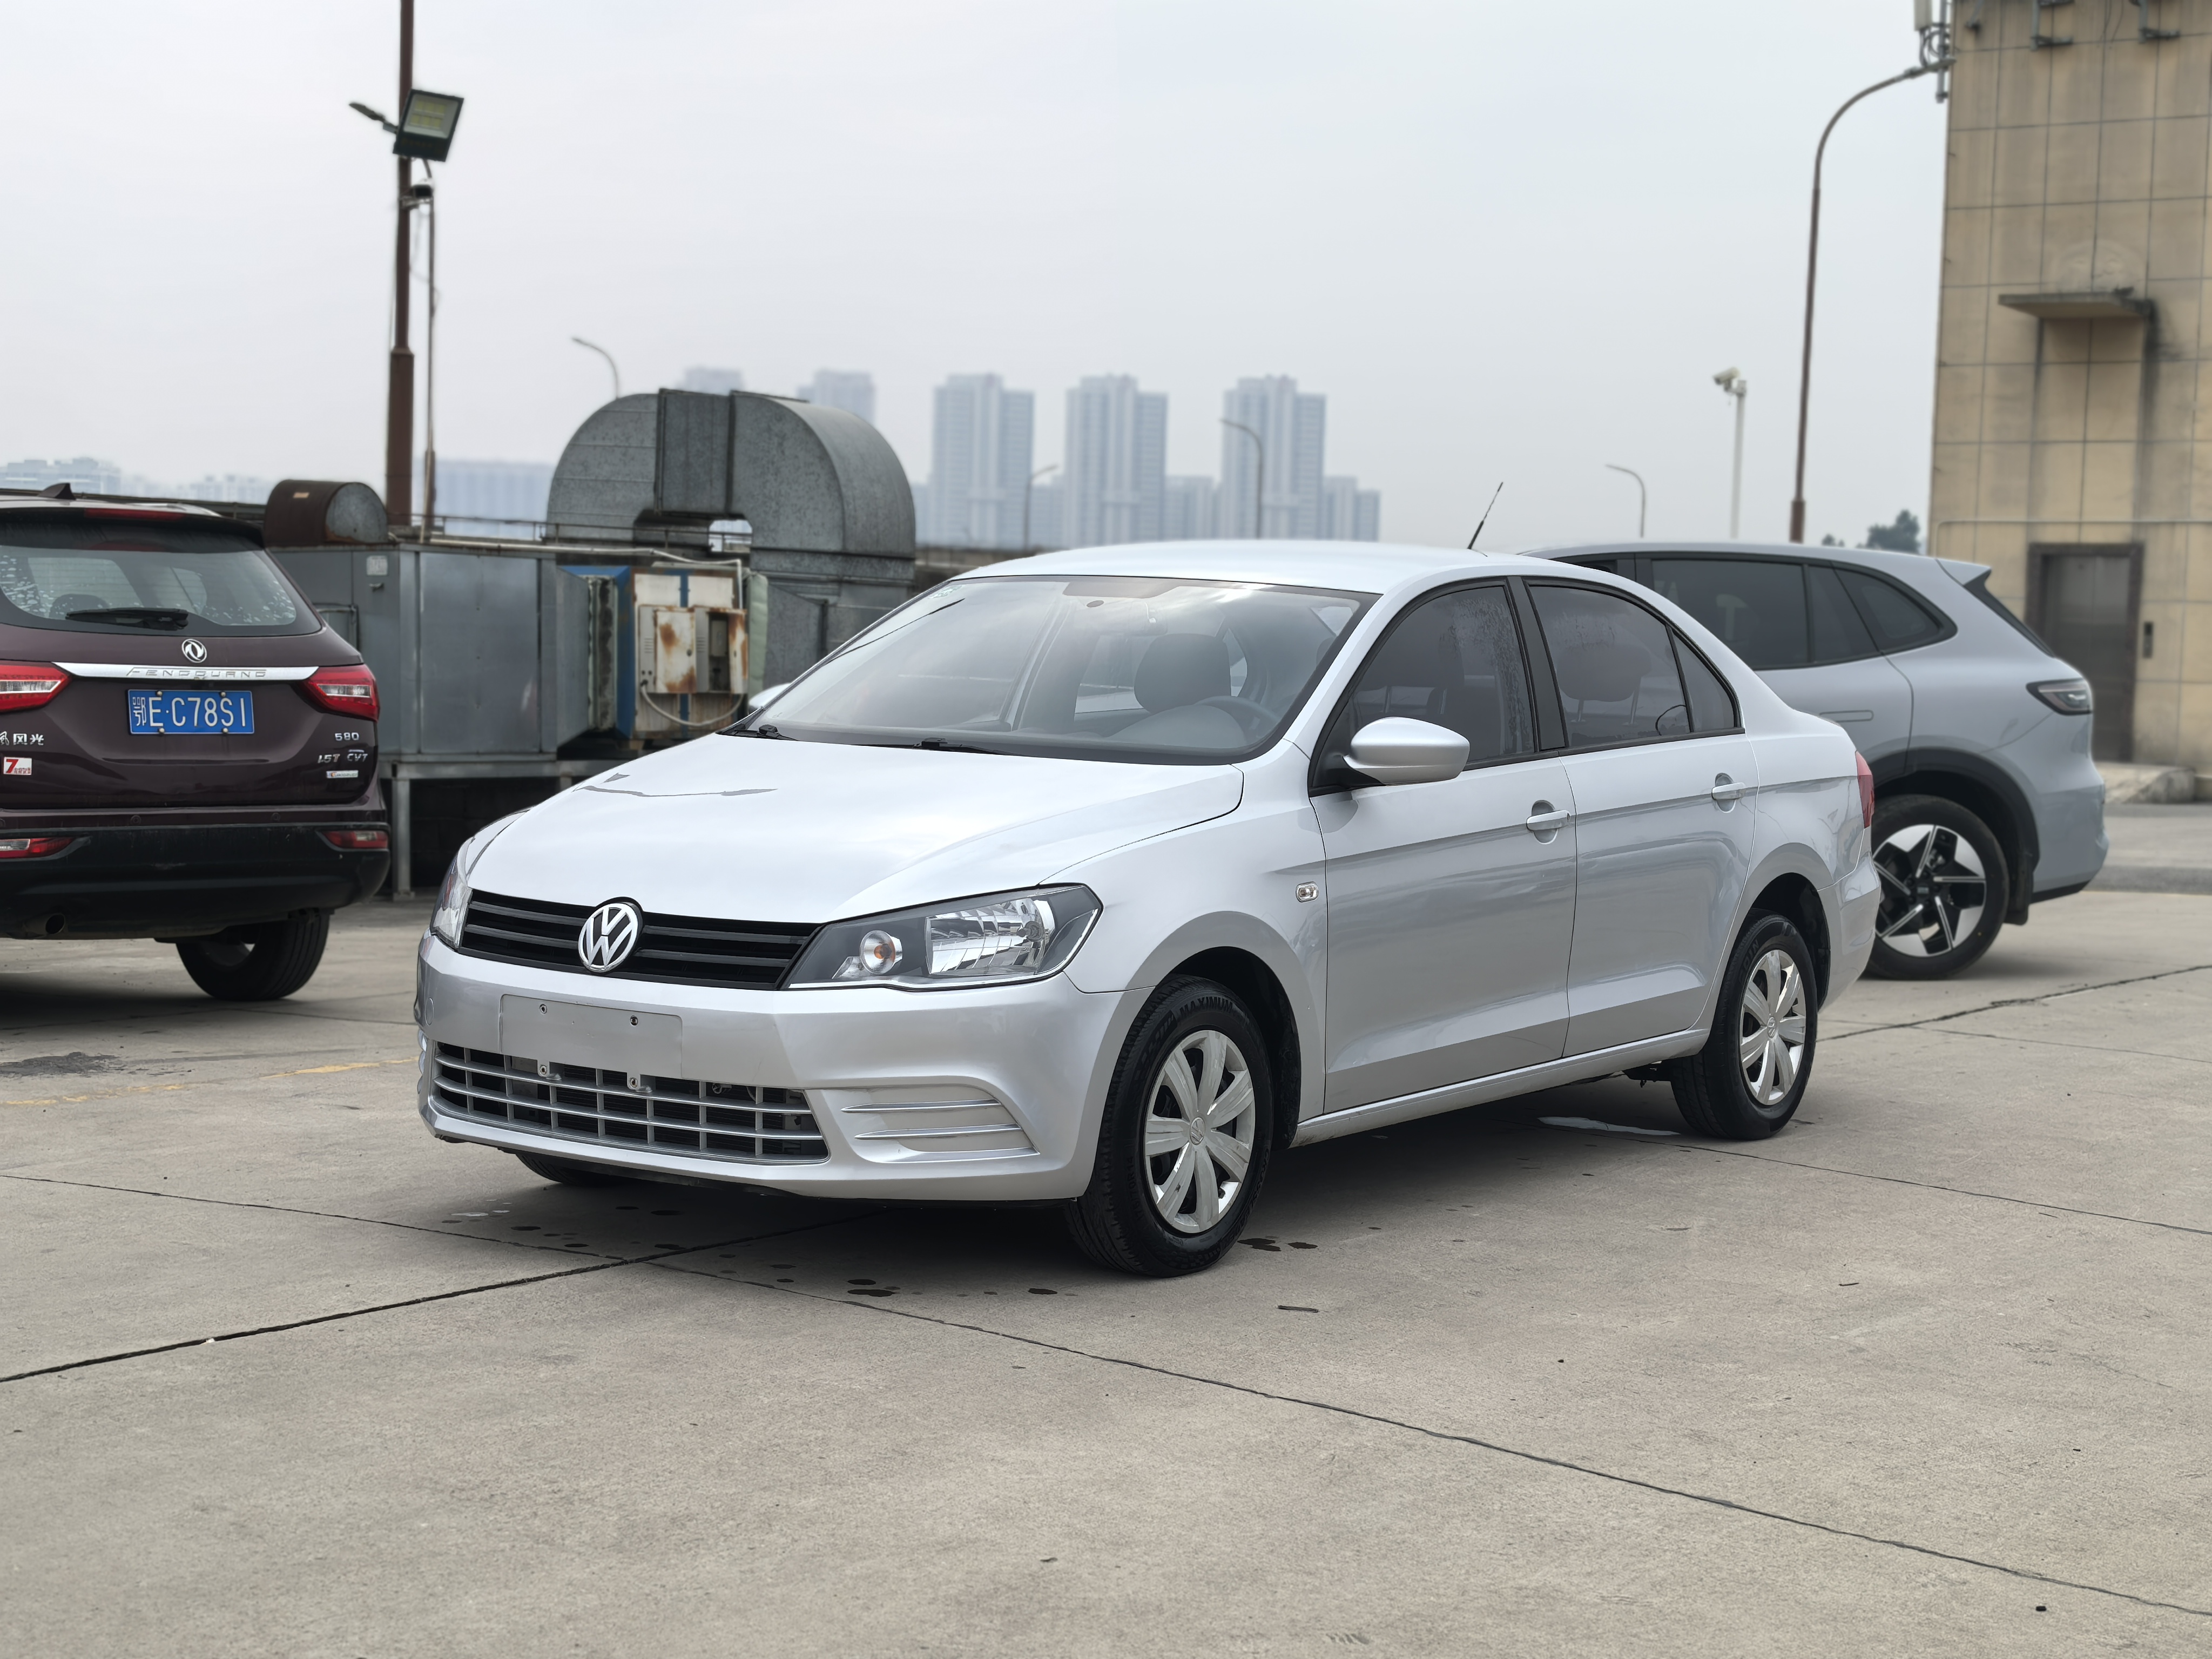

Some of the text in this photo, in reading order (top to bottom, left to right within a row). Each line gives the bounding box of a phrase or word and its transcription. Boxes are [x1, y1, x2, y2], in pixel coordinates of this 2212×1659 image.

[126, 667, 267, 678] FENGGUANG
[335, 732, 360, 741] 580
[347, 753, 368, 763] CVT
[6, 758, 19, 773] 7
